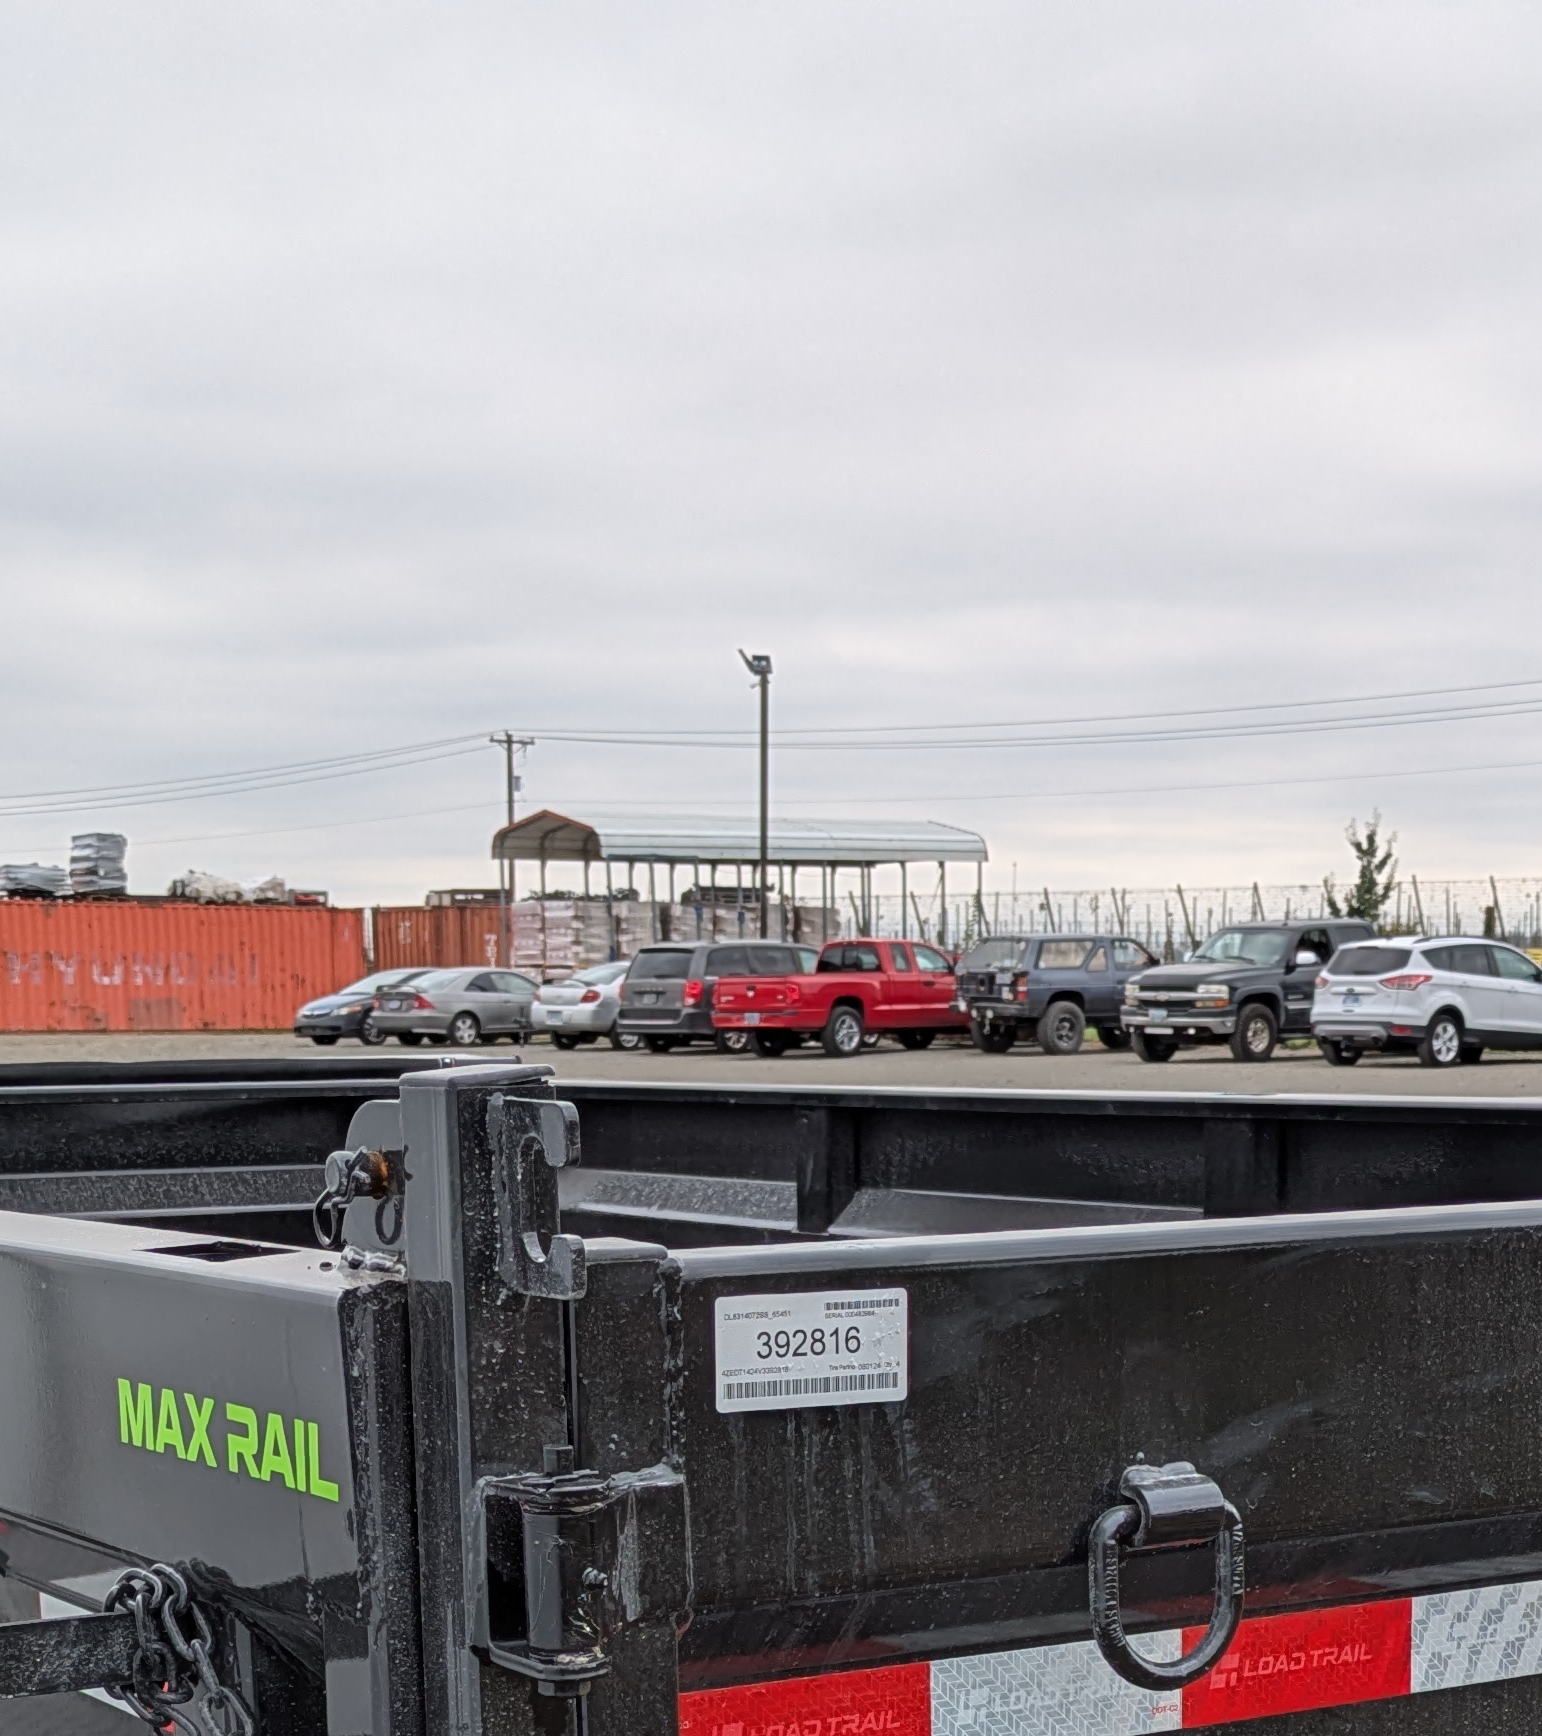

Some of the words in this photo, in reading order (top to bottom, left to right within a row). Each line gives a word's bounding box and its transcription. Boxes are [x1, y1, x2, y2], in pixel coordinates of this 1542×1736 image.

[757, 1326, 861, 1359] 392816
[118, 1378, 217, 1468] MAX
[226, 1402, 339, 1502] RAIL
[1243, 1652, 1305, 1677] LOAD
[1309, 1643, 1373, 1668] TRAIL
[826, 1709, 901, 1736] TRAIL
